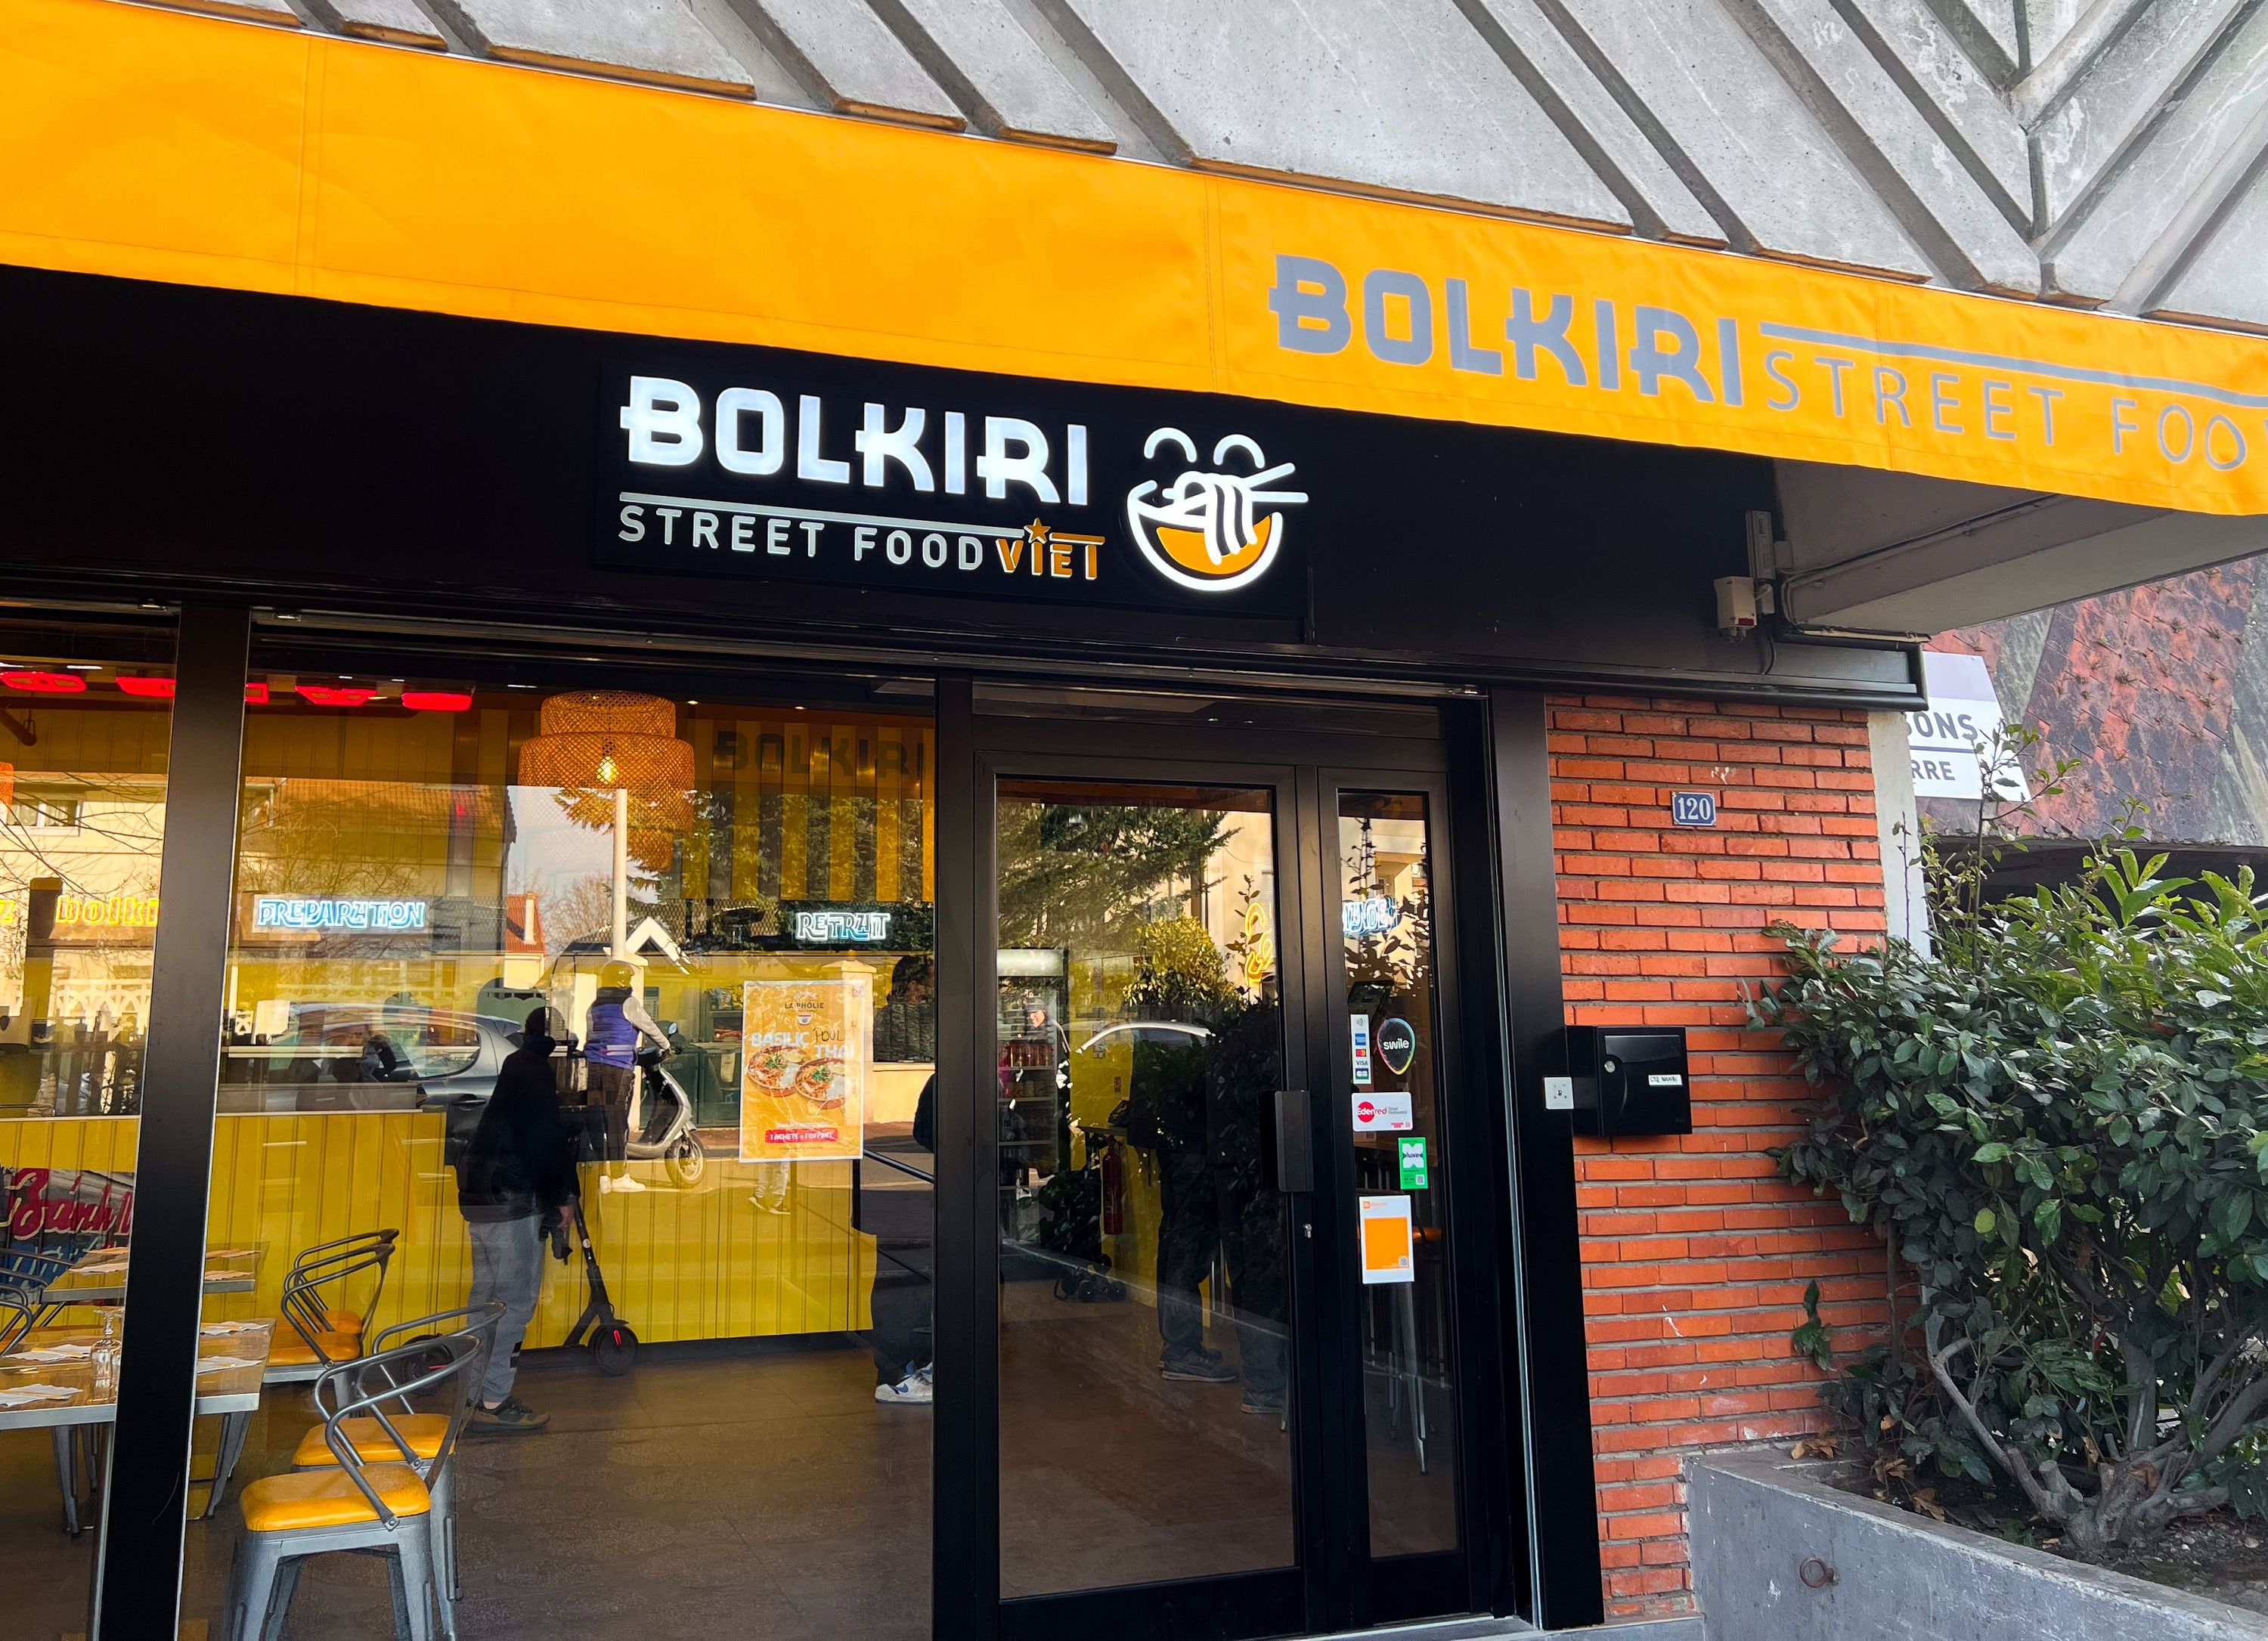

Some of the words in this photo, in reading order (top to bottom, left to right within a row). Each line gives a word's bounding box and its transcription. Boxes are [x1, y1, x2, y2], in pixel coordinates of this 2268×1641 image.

[1269, 254, 1744, 407] BOLKIRI
[1766, 348, 2065, 446] STREET
[2114, 395, 2268, 471] FOO
[620, 375, 1087, 505] BOLKIRI
[618, 503, 822, 558] STREET
[854, 525, 984, 572] FOOD
[996, 535, 1102, 581] VIET
[1906, 711, 1978, 740] ONS
[1678, 797, 1711, 820] 120
[1383, 1038, 1409, 1050] swile
